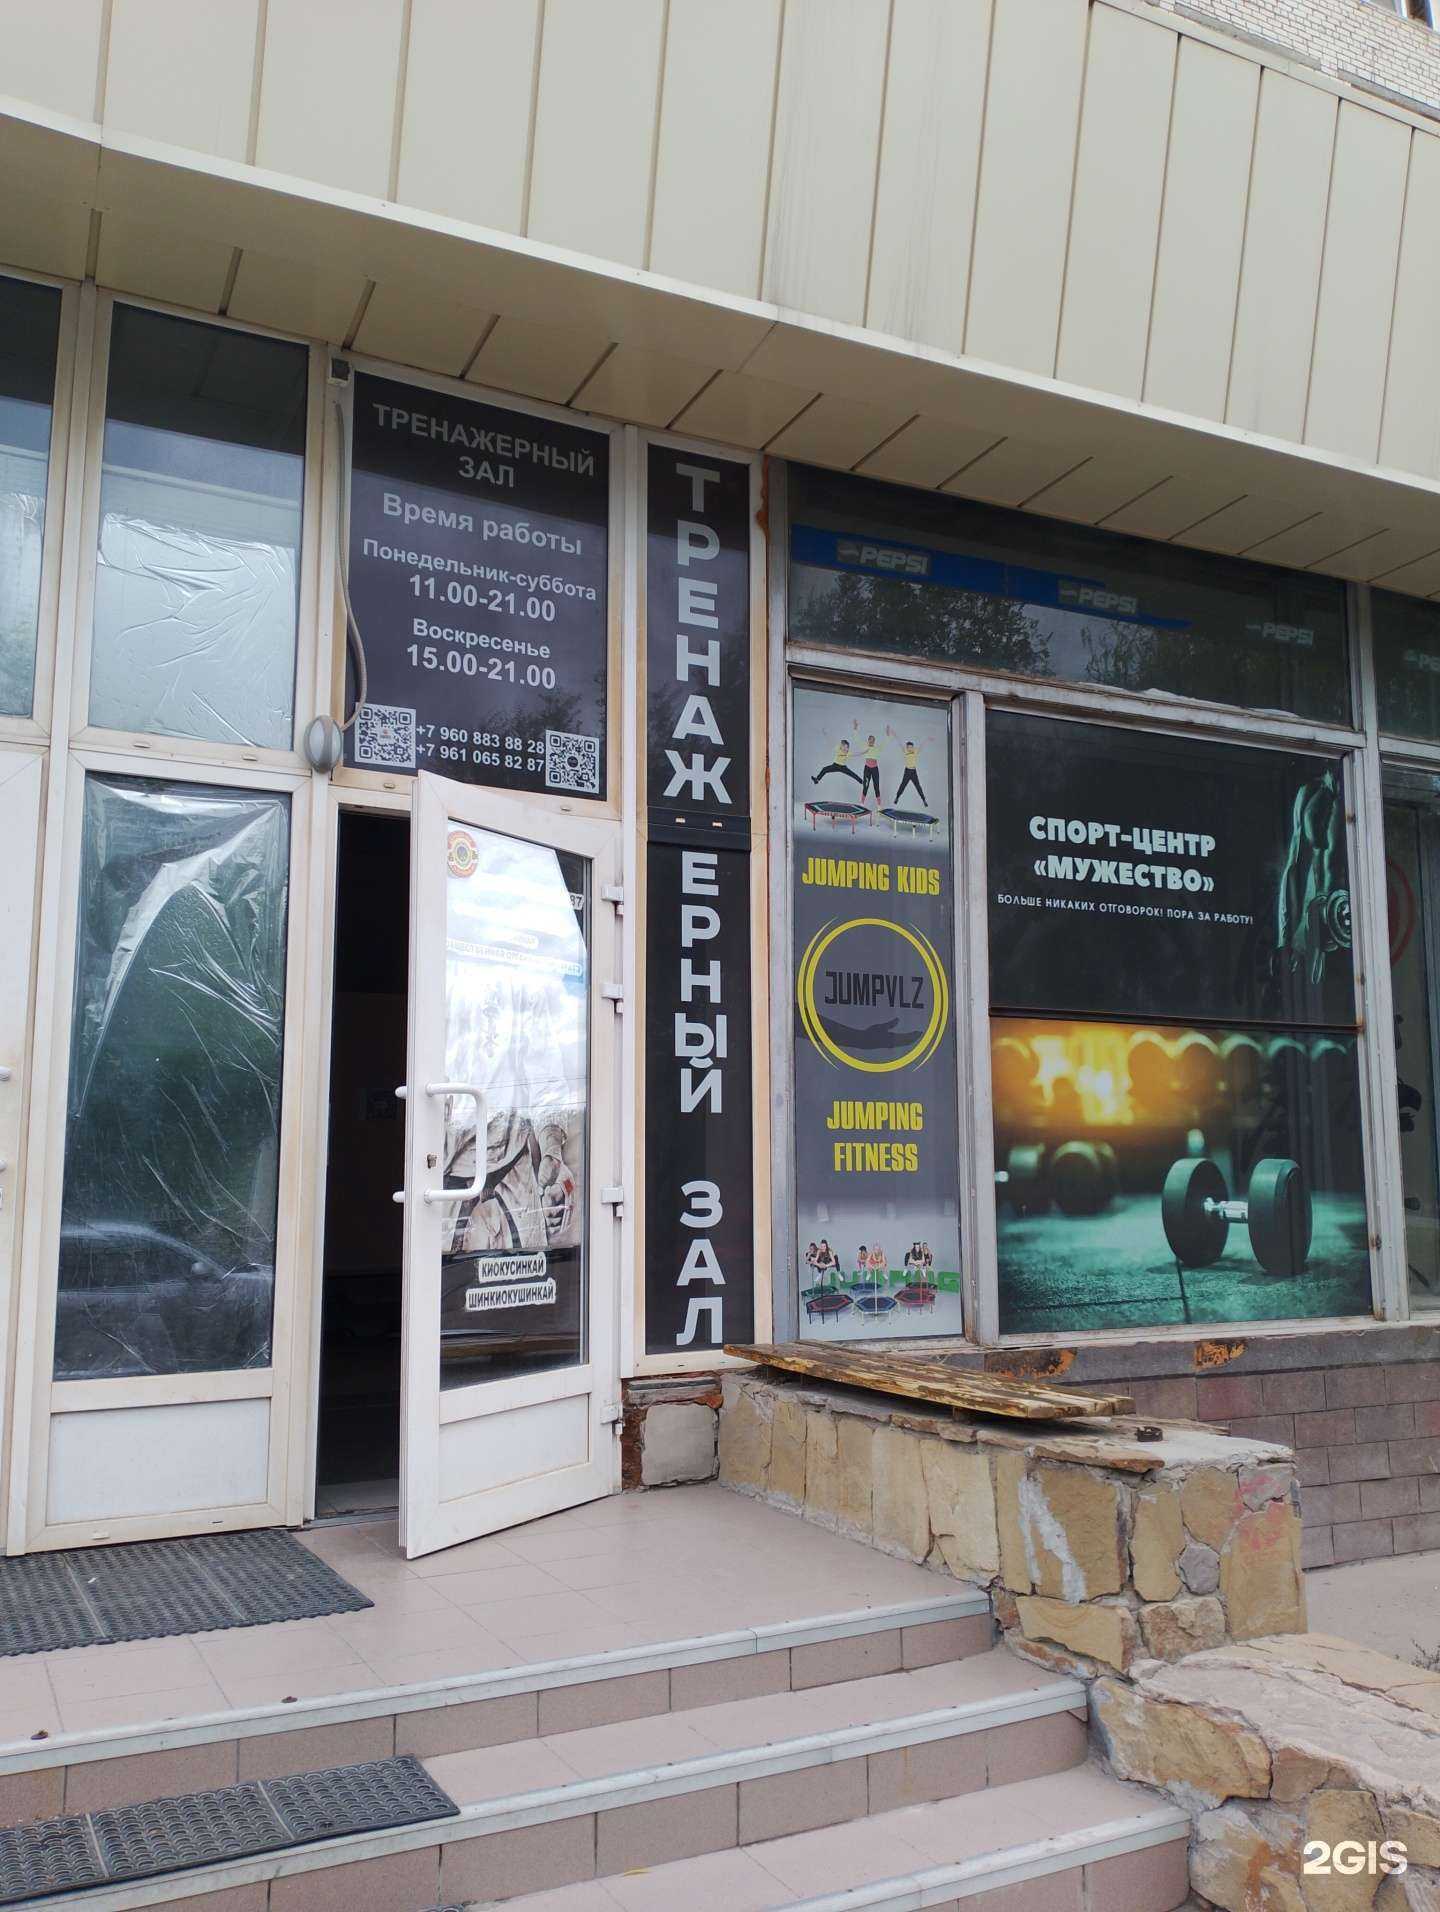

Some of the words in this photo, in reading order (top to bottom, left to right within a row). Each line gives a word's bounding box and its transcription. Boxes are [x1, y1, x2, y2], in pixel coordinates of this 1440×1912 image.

[372, 403, 595, 477] ТРЕНАЖЕРНЫЙ
[458, 456, 515, 488] ЗАЛ
[383, 492, 473, 532] Время
[482, 518, 582, 555] работы
[363, 538, 597, 600] Понедельник-суббота
[859, 546, 929, 575] PEPSI
[409, 574, 556, 622] 11.00-21.00
[1078, 587, 1137, 615] PEPSI
[413, 618, 551, 659] Воскресенье
[1262, 621, 1314, 646] PEPSI
[407, 644, 556, 690] 15.00-21.00
[416, 724, 436, 738] +7
[440, 726, 468, 743] 960
[473, 731, 500, 748] 883
[504, 736, 522, 751] 88
[527, 739, 544, 754] 28
[416, 743, 436, 757] +7
[440, 745, 467, 762] 961
[473, 750, 500, 766] 065
[504, 755, 522, 770] 82
[527, 758, 544, 772] 87
[1028, 815, 1216, 858] СПОРТ-ЦЕНТР
[802, 857, 890, 892] JUMPING
[897, 865, 940, 896] KIDS
[1033, 854, 1215, 893] «МУЖЕСТВО»
[997, 894, 1042, 908] БОЛЬШЕ
[1045, 898, 1096, 913] НИКАКИХ
[1099, 902, 1164, 918] ОТГОВОРОК!
[1167, 908, 1195, 920] ПОРА
[1197, 911, 1211, 921] ЗА
[1213, 914, 1254, 926] РАБОТУ!
[826, 1100, 924, 1131] JUMPING
[834, 1142, 919, 1172] FITNESS
[481, 1255, 544, 1278] КИОКУСИНКАЙ
[675, 1180, 727, 1346] ЗАЛ
[468, 1282, 554, 1309] ШИНКИОКУШИНКАЙ
